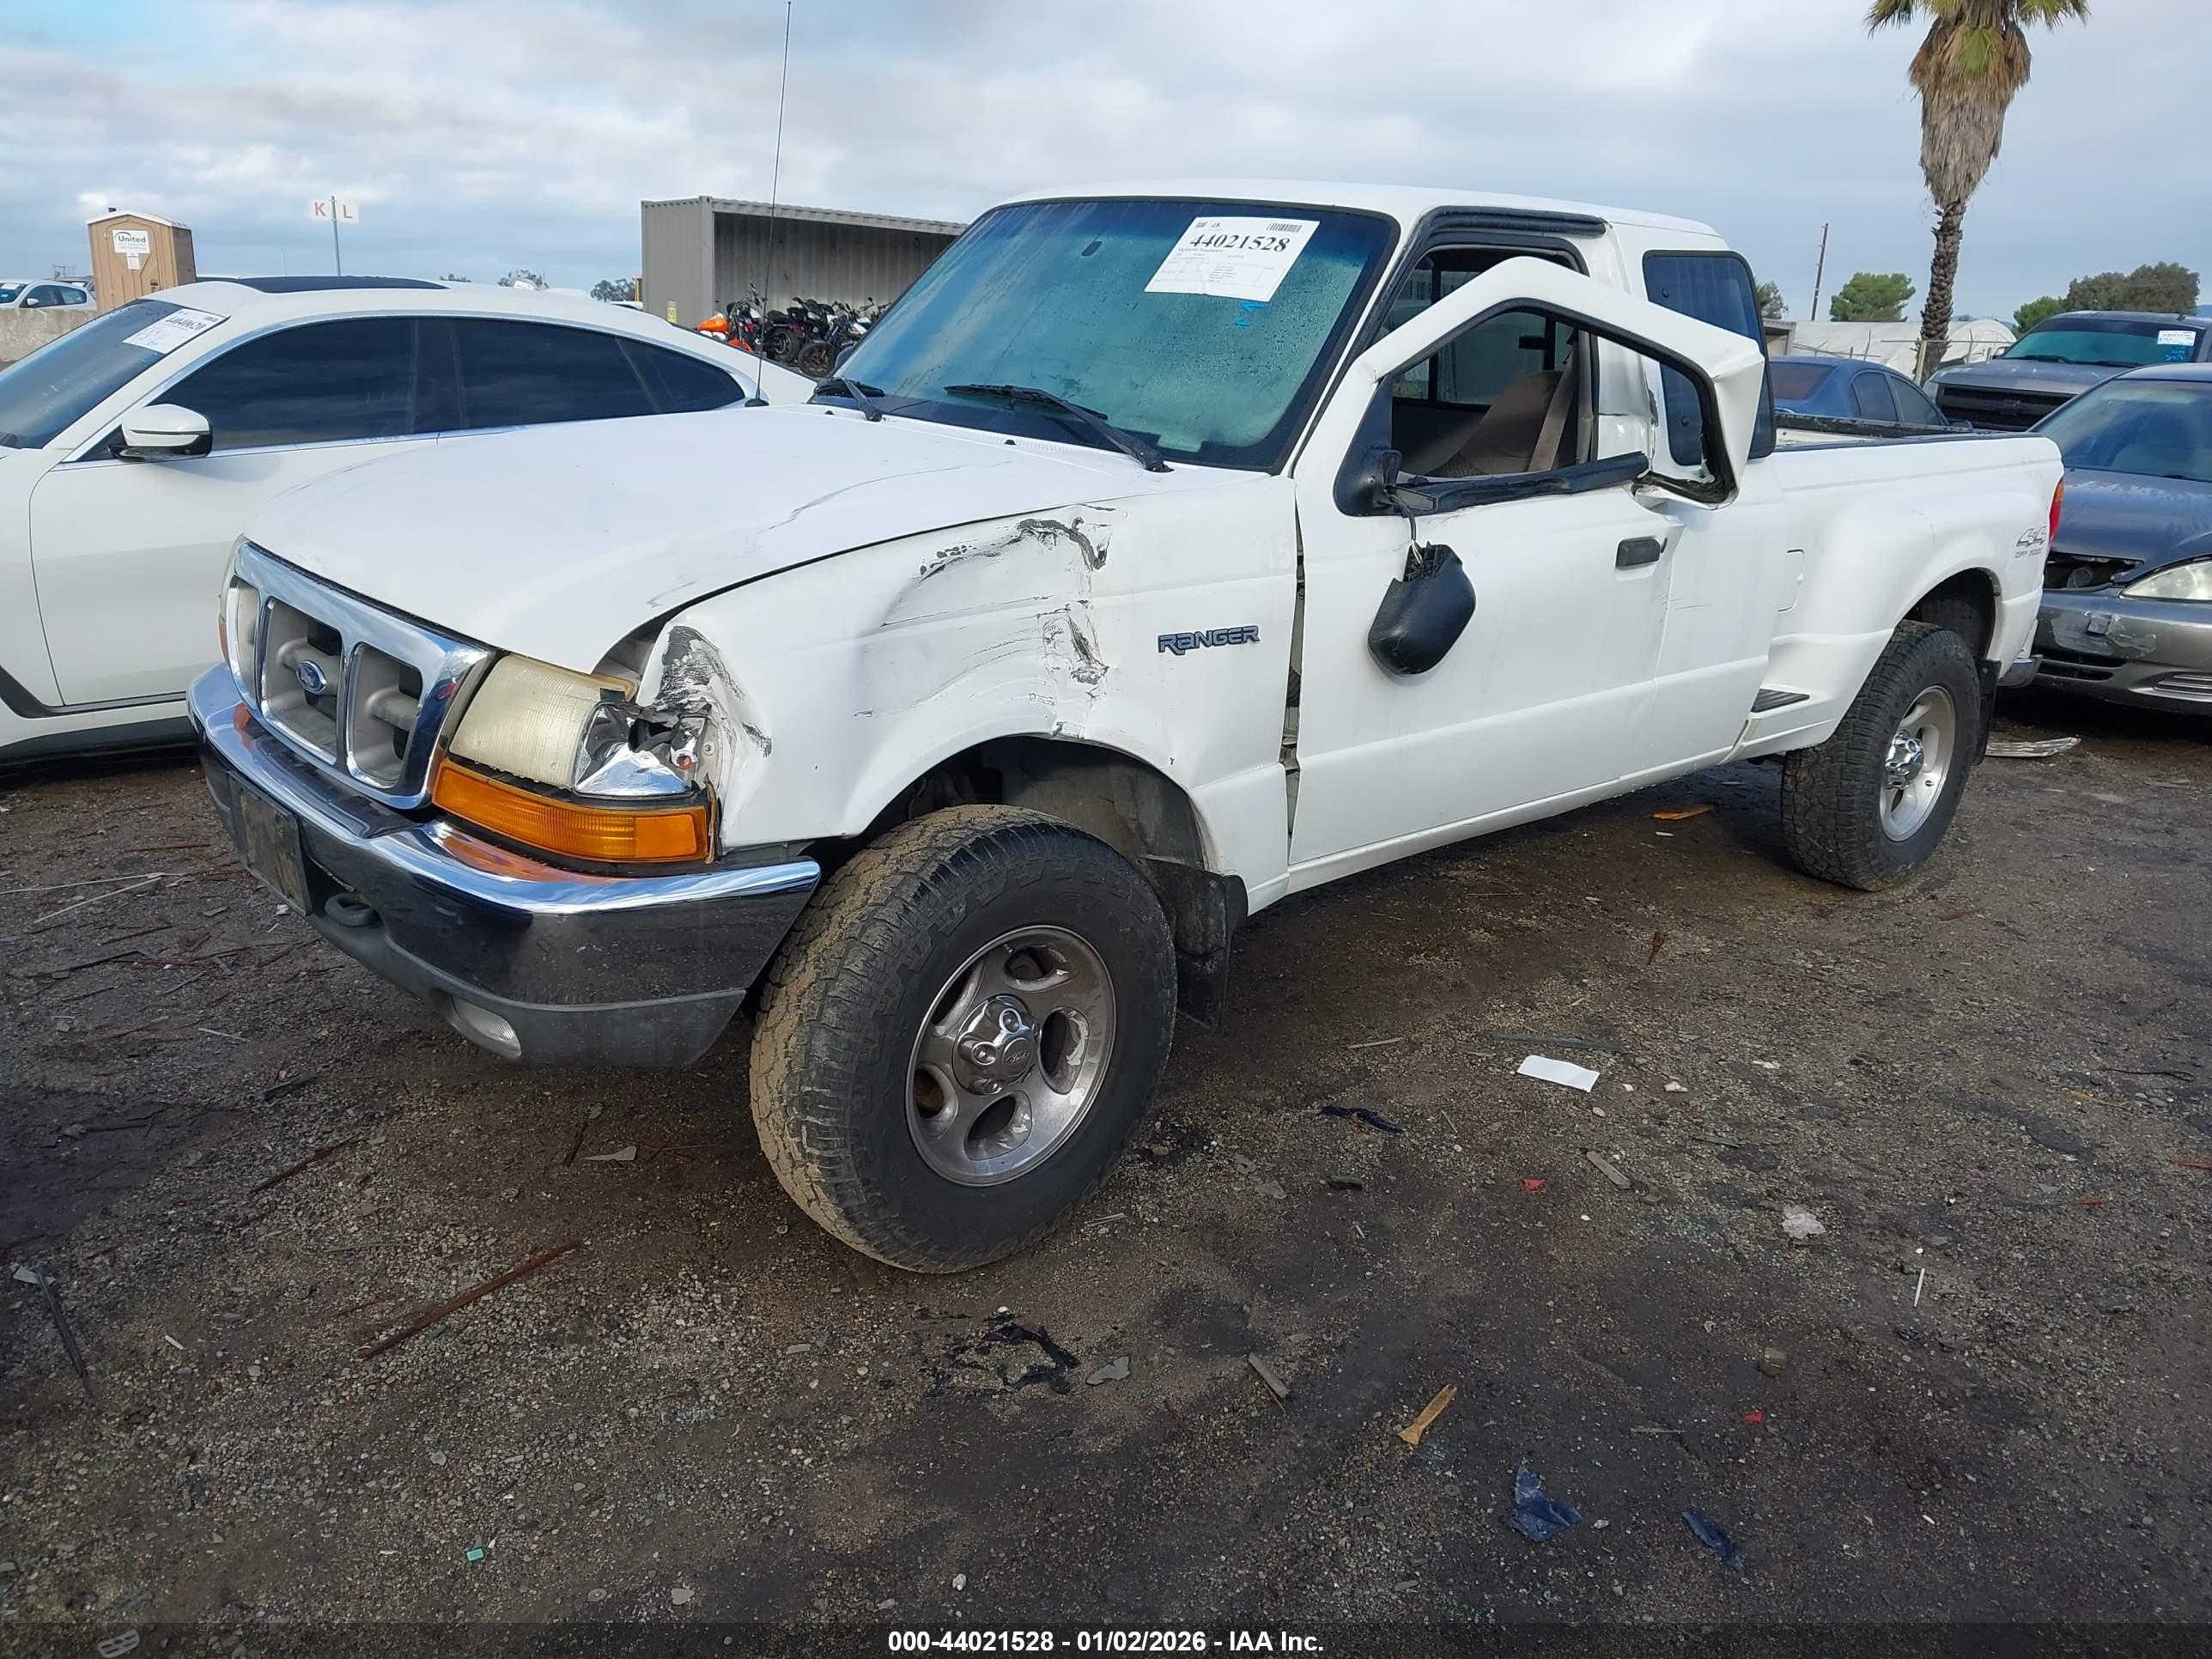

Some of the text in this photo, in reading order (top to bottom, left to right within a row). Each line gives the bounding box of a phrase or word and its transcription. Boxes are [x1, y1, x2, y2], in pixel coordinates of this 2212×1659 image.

[314, 202, 326, 216] K
[343, 204, 353, 219] L
[1190, 234, 1290, 252] 44021528
